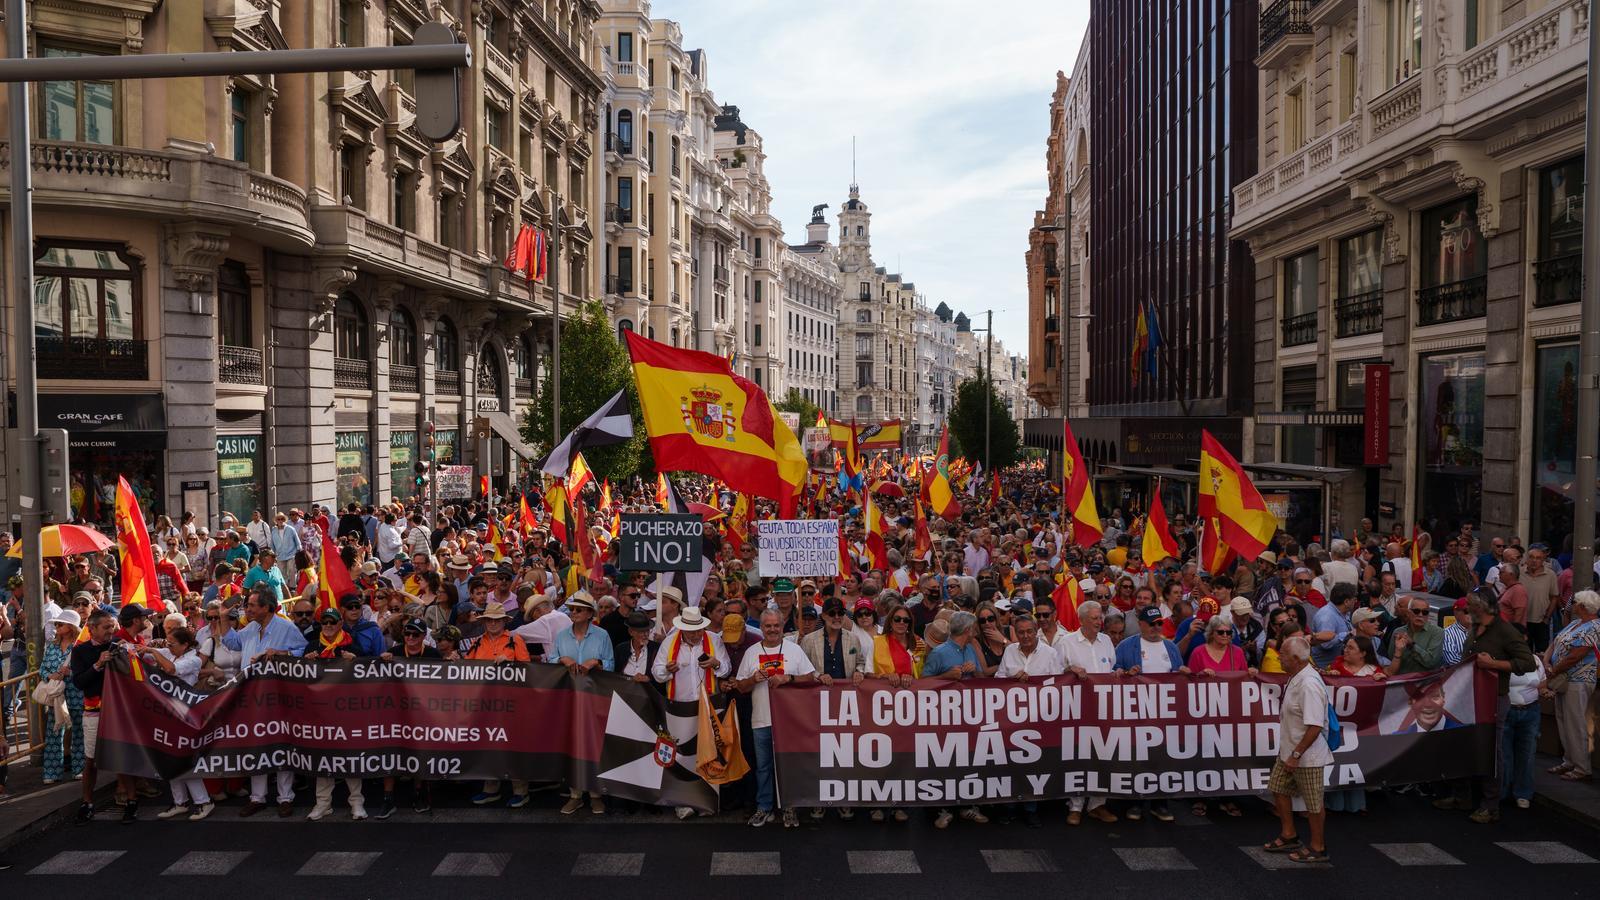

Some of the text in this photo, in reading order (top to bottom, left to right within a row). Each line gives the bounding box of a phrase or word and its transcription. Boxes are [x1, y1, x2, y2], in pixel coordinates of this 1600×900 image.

[216, 438, 257, 454] CASINO
[335, 434, 365, 448] CASINO
[620, 521, 703, 536] PUCHERAZO
[758, 520, 838, 534] CEUTA TODA ESPAÑA
[812, 536, 838, 549] MENOS
[634, 541, 691, 564] ¡NO!
[769, 550, 837, 562] EL GOBIERNO
[781, 562, 837, 576] MARCIANO
[242, 659, 317, 679] TRAICIÓN
[353, 660, 442, 680] SÁNCHEZ
[447, 661, 527, 682] DIMISIÓN
[335, 695, 394, 712] CEUTA
[399, 695, 421, 711] SE
[428, 696, 515, 713] DEFIENDE
[819, 677, 1357, 727] LA CORRUPCIÓN TIENE UN PRO
[153, 727, 173, 746] EL
[177, 723, 248, 749] PUEBLO
[253, 720, 290, 739] CON
[292, 723, 347, 742] CEUTA
[367, 724, 480, 743] ELECCIONES
[485, 727, 508, 742] YA
[819, 721, 1359, 768] NO MÁS IMPUNIDD
[193, 748, 461, 775] APLICACIÓN ARTÍCULO 102
[819, 773, 1012, 801] DIMISIÓN
[1026, 774, 1051, 796] Y
[1064, 767, 1271, 794] ELECCIONE
